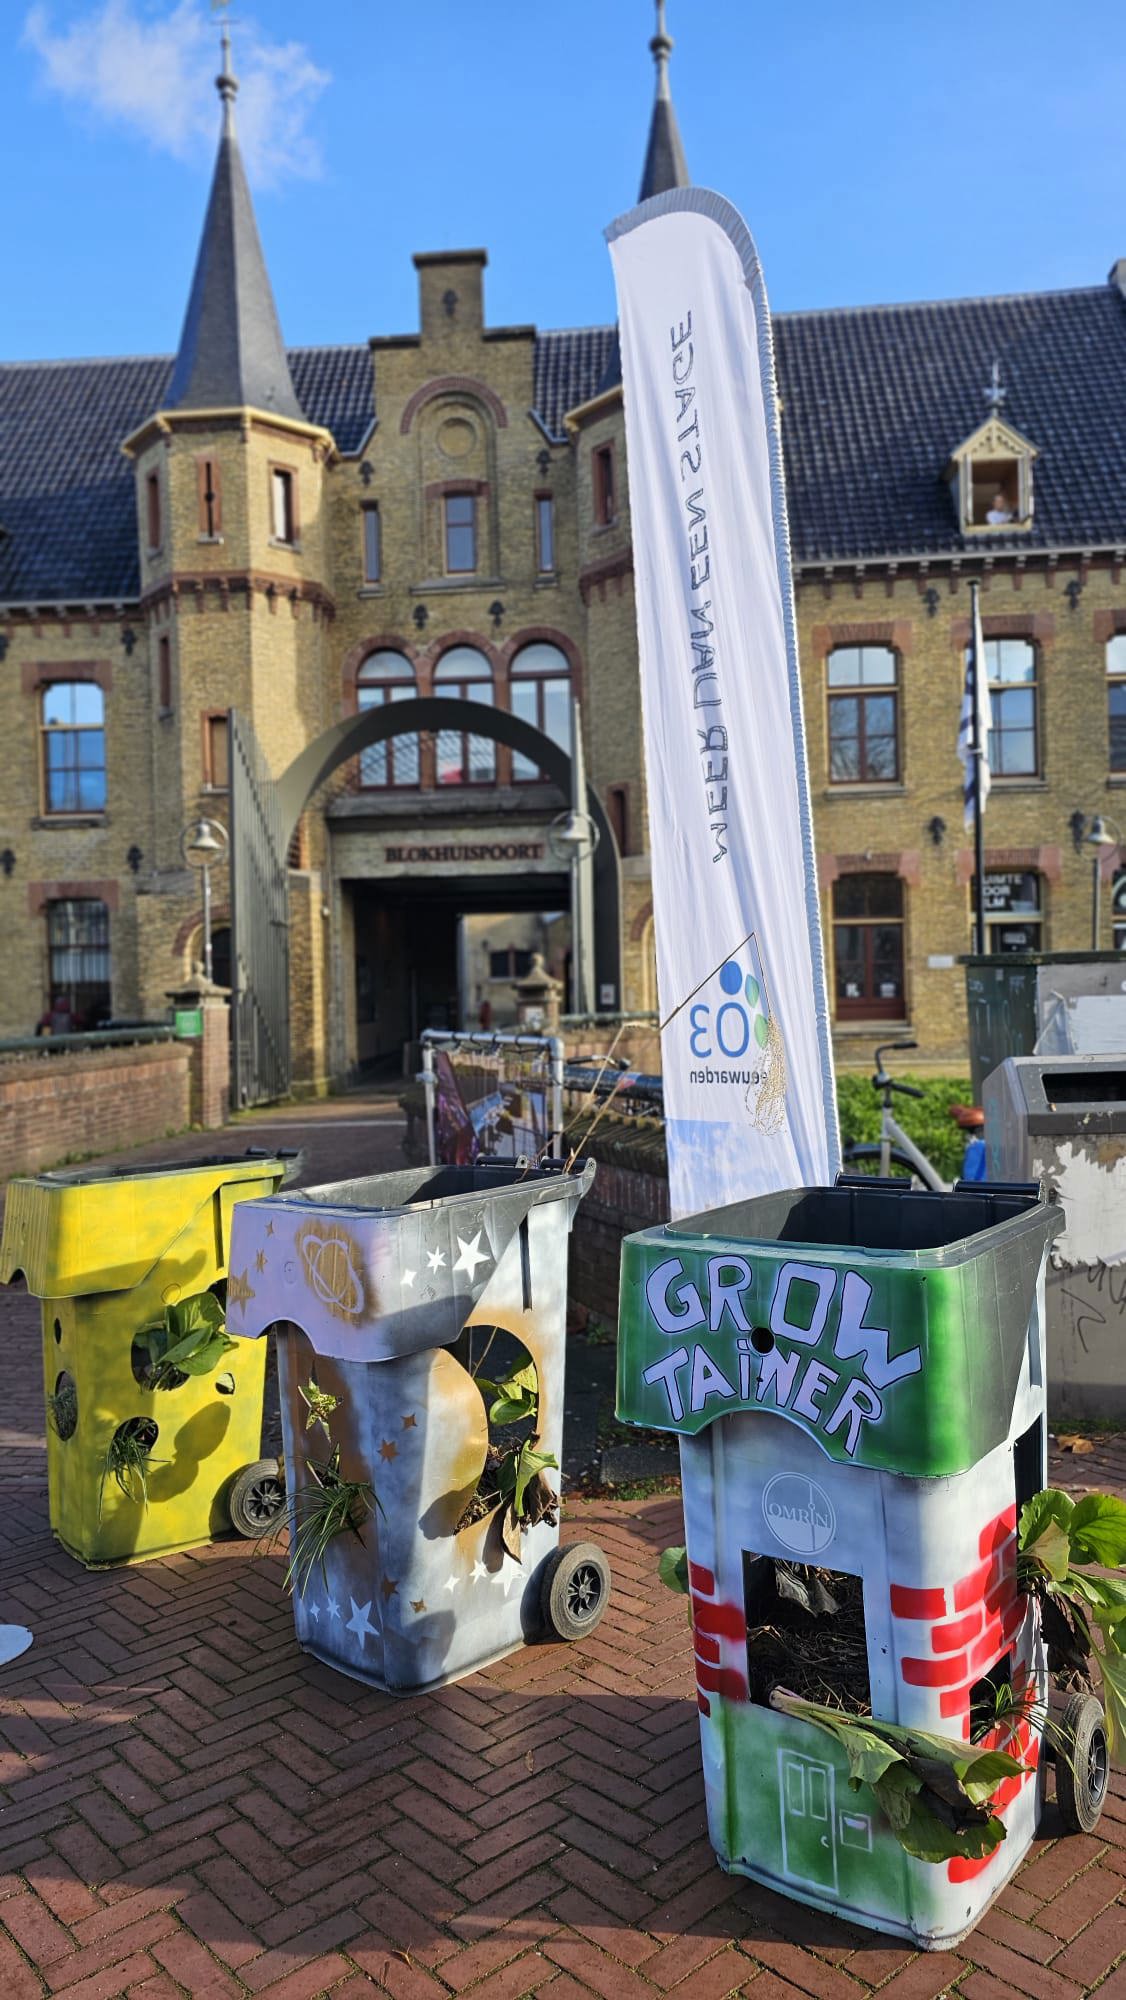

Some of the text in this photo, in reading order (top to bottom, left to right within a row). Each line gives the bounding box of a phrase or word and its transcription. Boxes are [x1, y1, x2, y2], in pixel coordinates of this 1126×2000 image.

[385, 843, 544, 863] BLOKHUISPOORT
[982, 874, 1023, 884] UIMTE
[982, 885, 1010, 896] OOR
[646, 1255, 922, 1390] GROW
[769, 1502, 831, 1529] OMRIN
